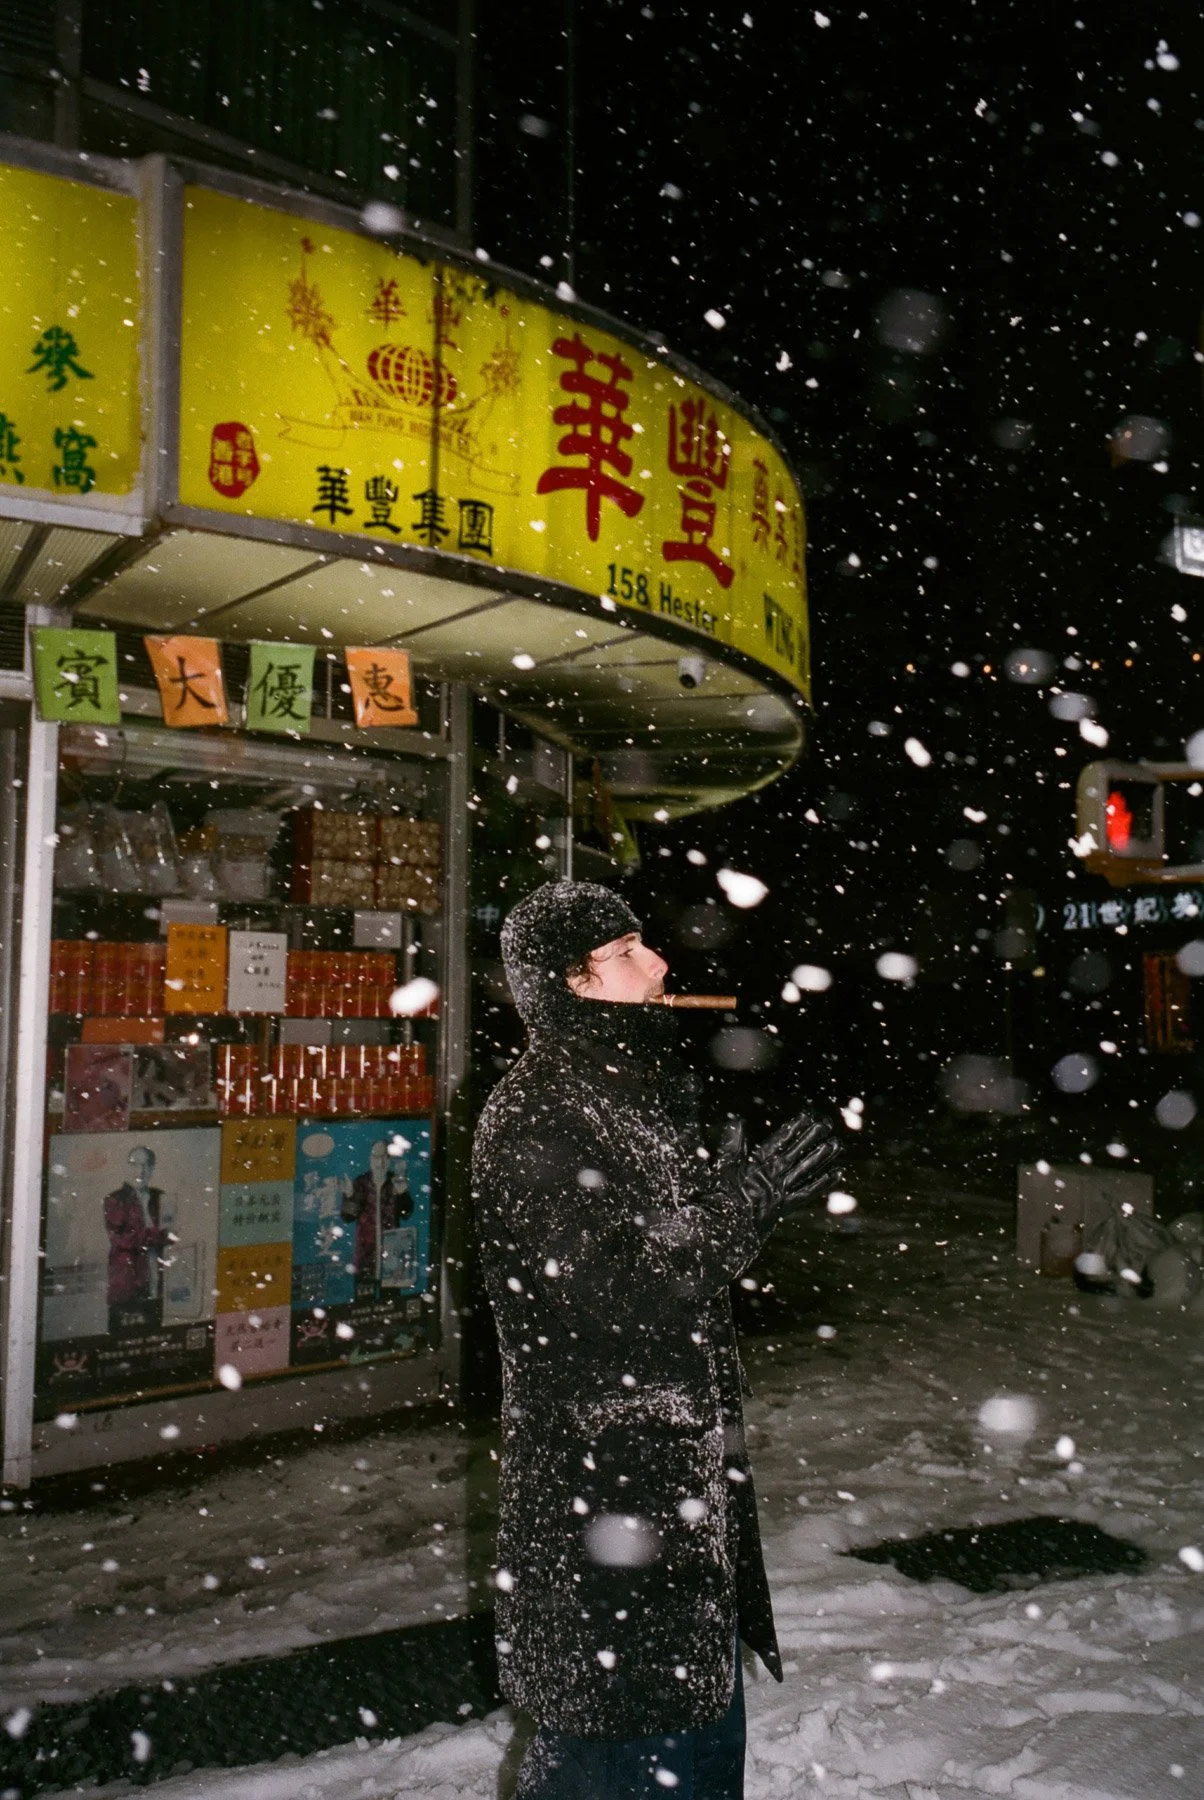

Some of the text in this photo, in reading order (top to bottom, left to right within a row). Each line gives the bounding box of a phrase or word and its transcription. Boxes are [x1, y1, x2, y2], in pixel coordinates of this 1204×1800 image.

[537, 333, 735, 588] 華豐
[312, 465, 494, 557] 華豐集團
[607, 563, 718, 633] 158 Hester
